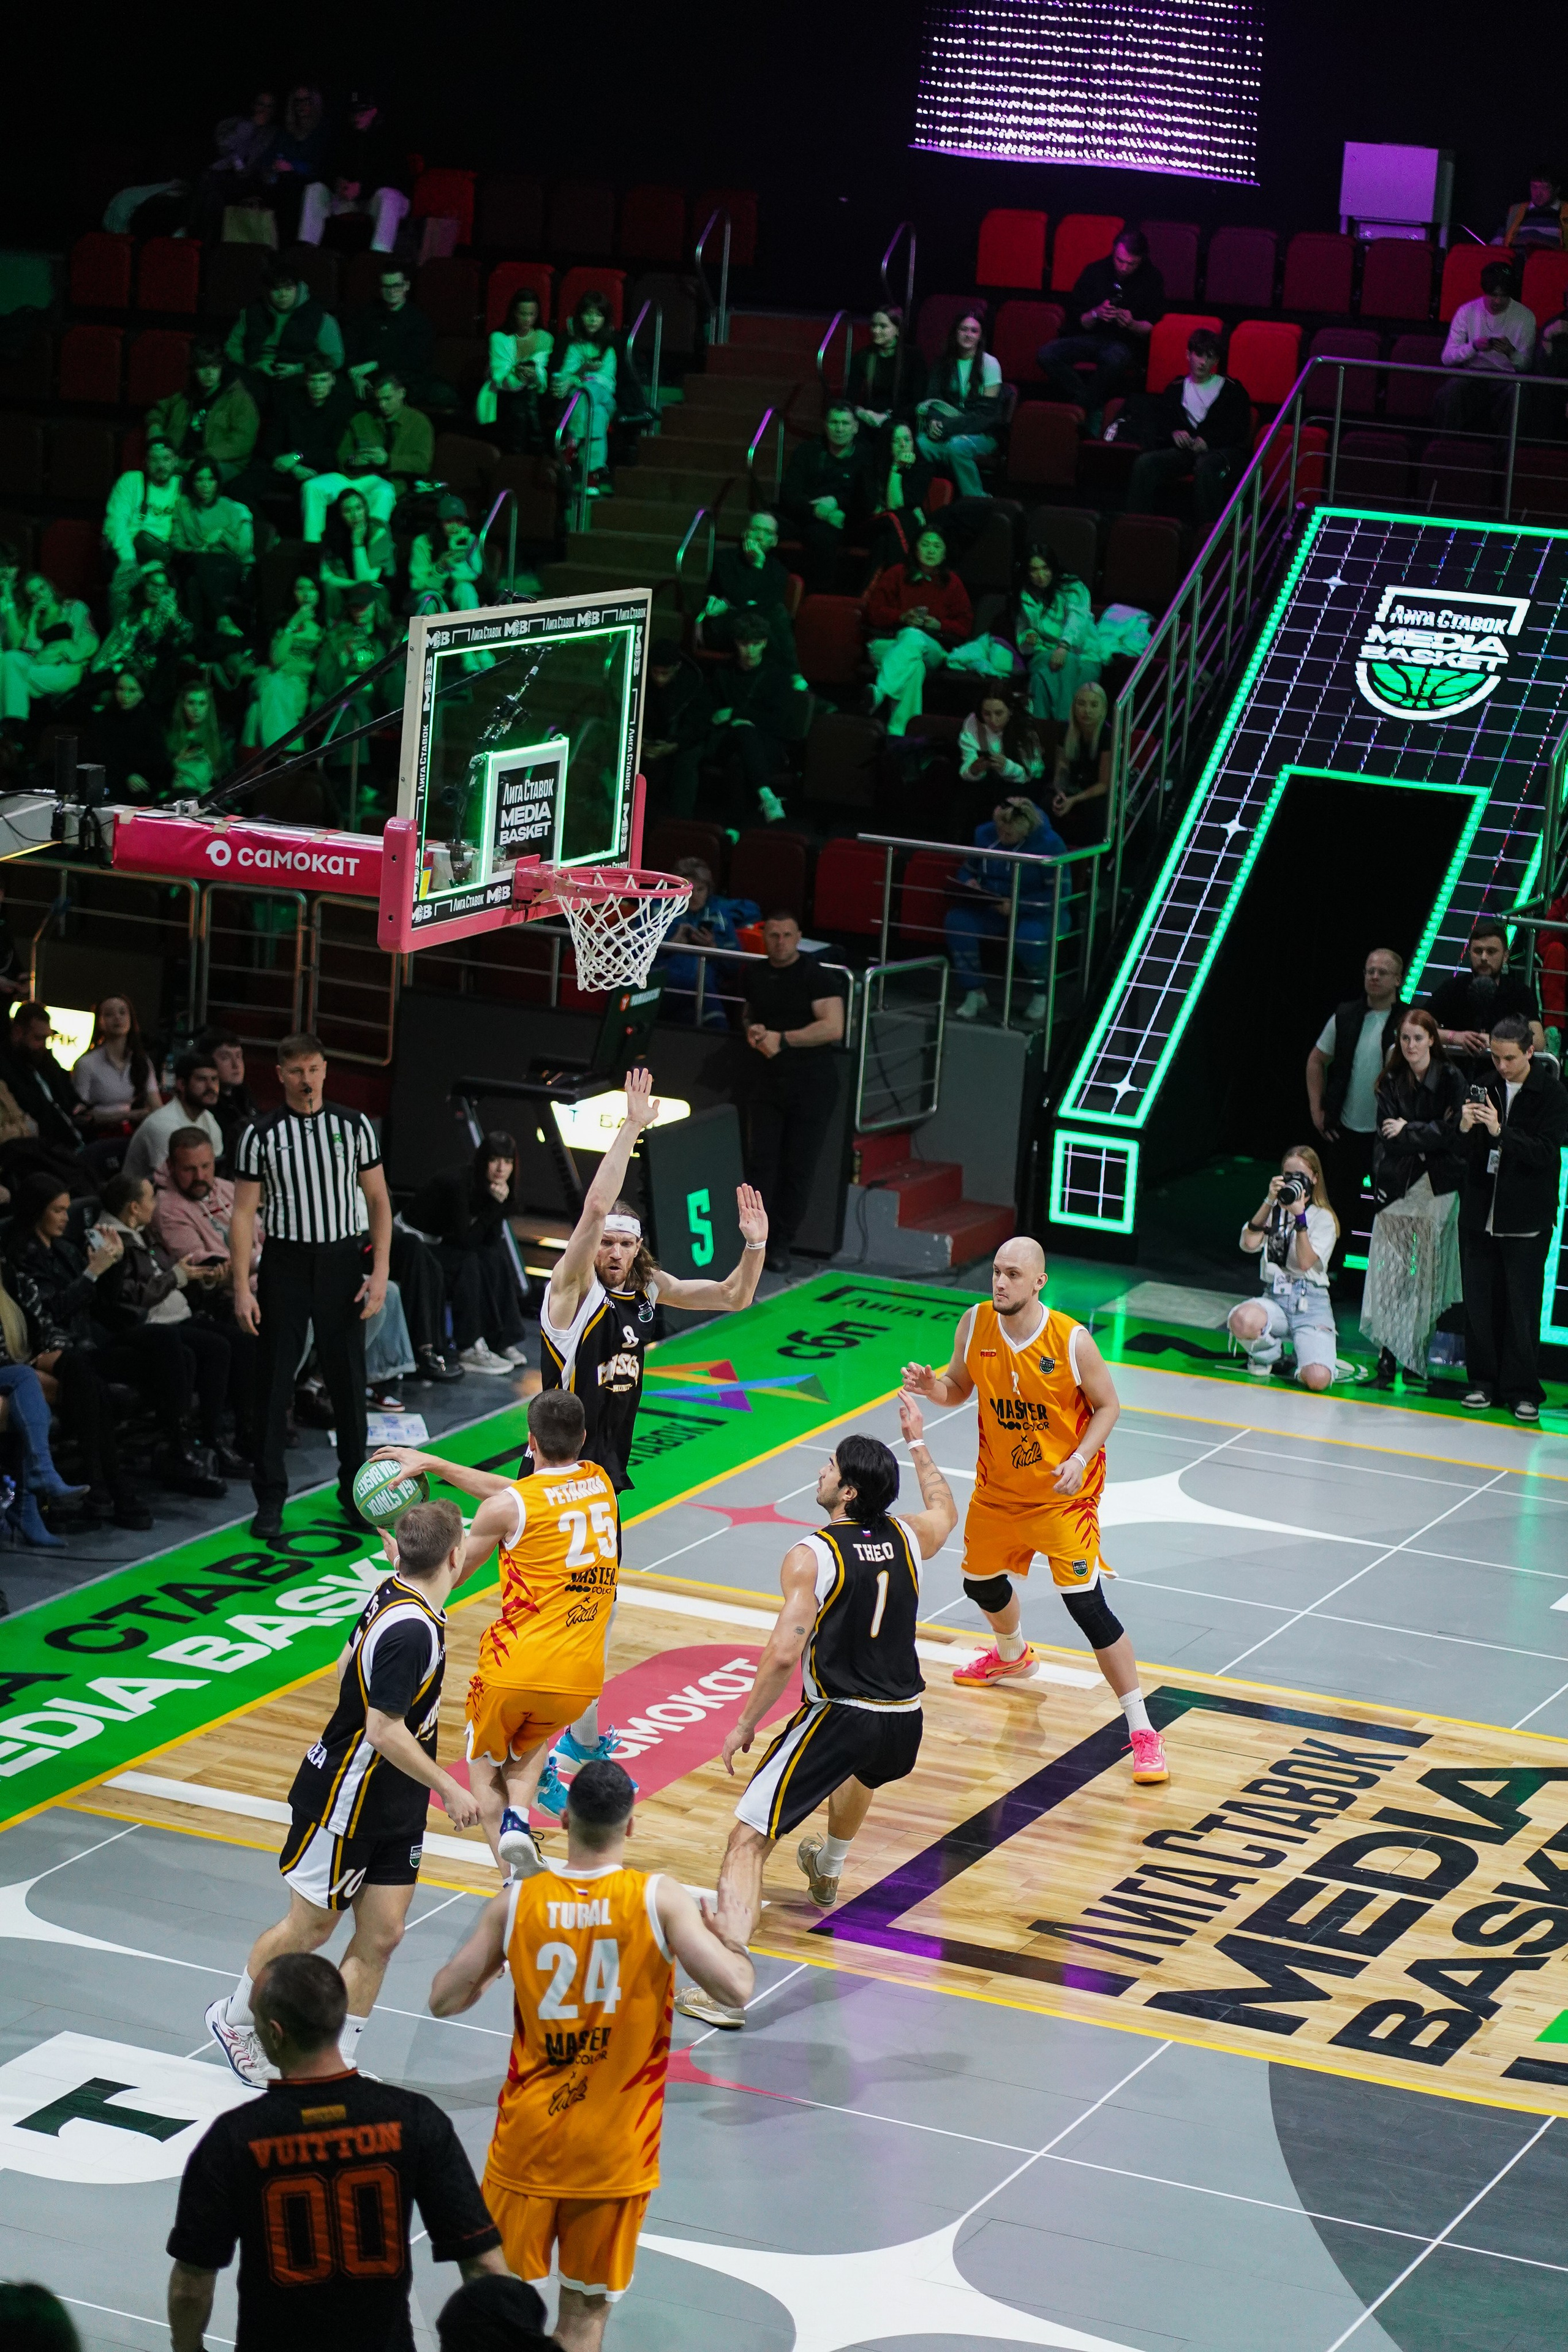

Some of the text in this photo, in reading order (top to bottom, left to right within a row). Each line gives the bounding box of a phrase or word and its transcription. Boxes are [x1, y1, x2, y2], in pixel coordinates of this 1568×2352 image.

[1358, 644, 1508, 672] BASKET
[1365, 624, 1509, 657] MEDIA
[499, 821, 551, 845] BASKET
[500, 801, 551, 828] MEDIA
[687, 1188, 714, 1267] 5
[990, 1398, 1048, 1420] MASTER
[558, 1502, 617, 1568] 25
[853, 1542, 894, 1561] THEO
[870, 1570, 889, 1638] 1
[0, 1550, 398, 1777] EDIA BASK
[603, 1657, 758, 1760] амокат
[1027, 1738, 1409, 1966] ЛИГА СТАВОК
[329, 1866, 367, 1898] 10
[1143, 1768, 1568, 2036] MEDIA
[547, 1898, 612, 1929] TURAL
[1327, 1822, 1568, 2067] BASK
[536, 1939, 621, 2020] 24
[545, 2027, 611, 2056] MASER
[248, 2121, 403, 2169] VUITTON
[262, 2162, 405, 2288] 00
